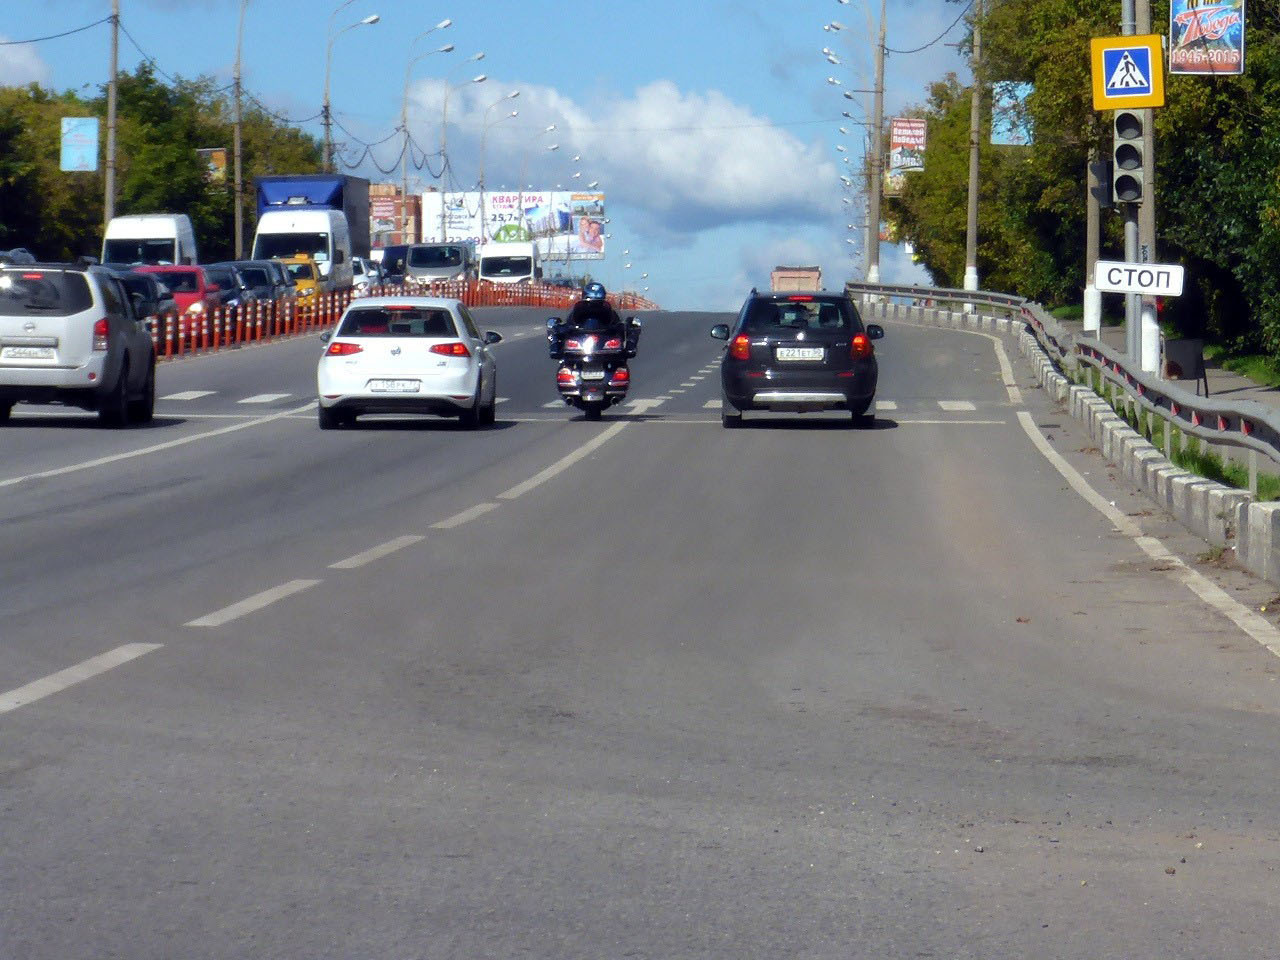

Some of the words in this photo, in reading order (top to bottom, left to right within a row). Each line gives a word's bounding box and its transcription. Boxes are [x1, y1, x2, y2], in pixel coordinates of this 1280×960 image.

[1173, 5, 1242, 48] Победа
[1172, 48, 1240, 65] 1945-2015
[1107, 267, 1171, 289] СТОП
